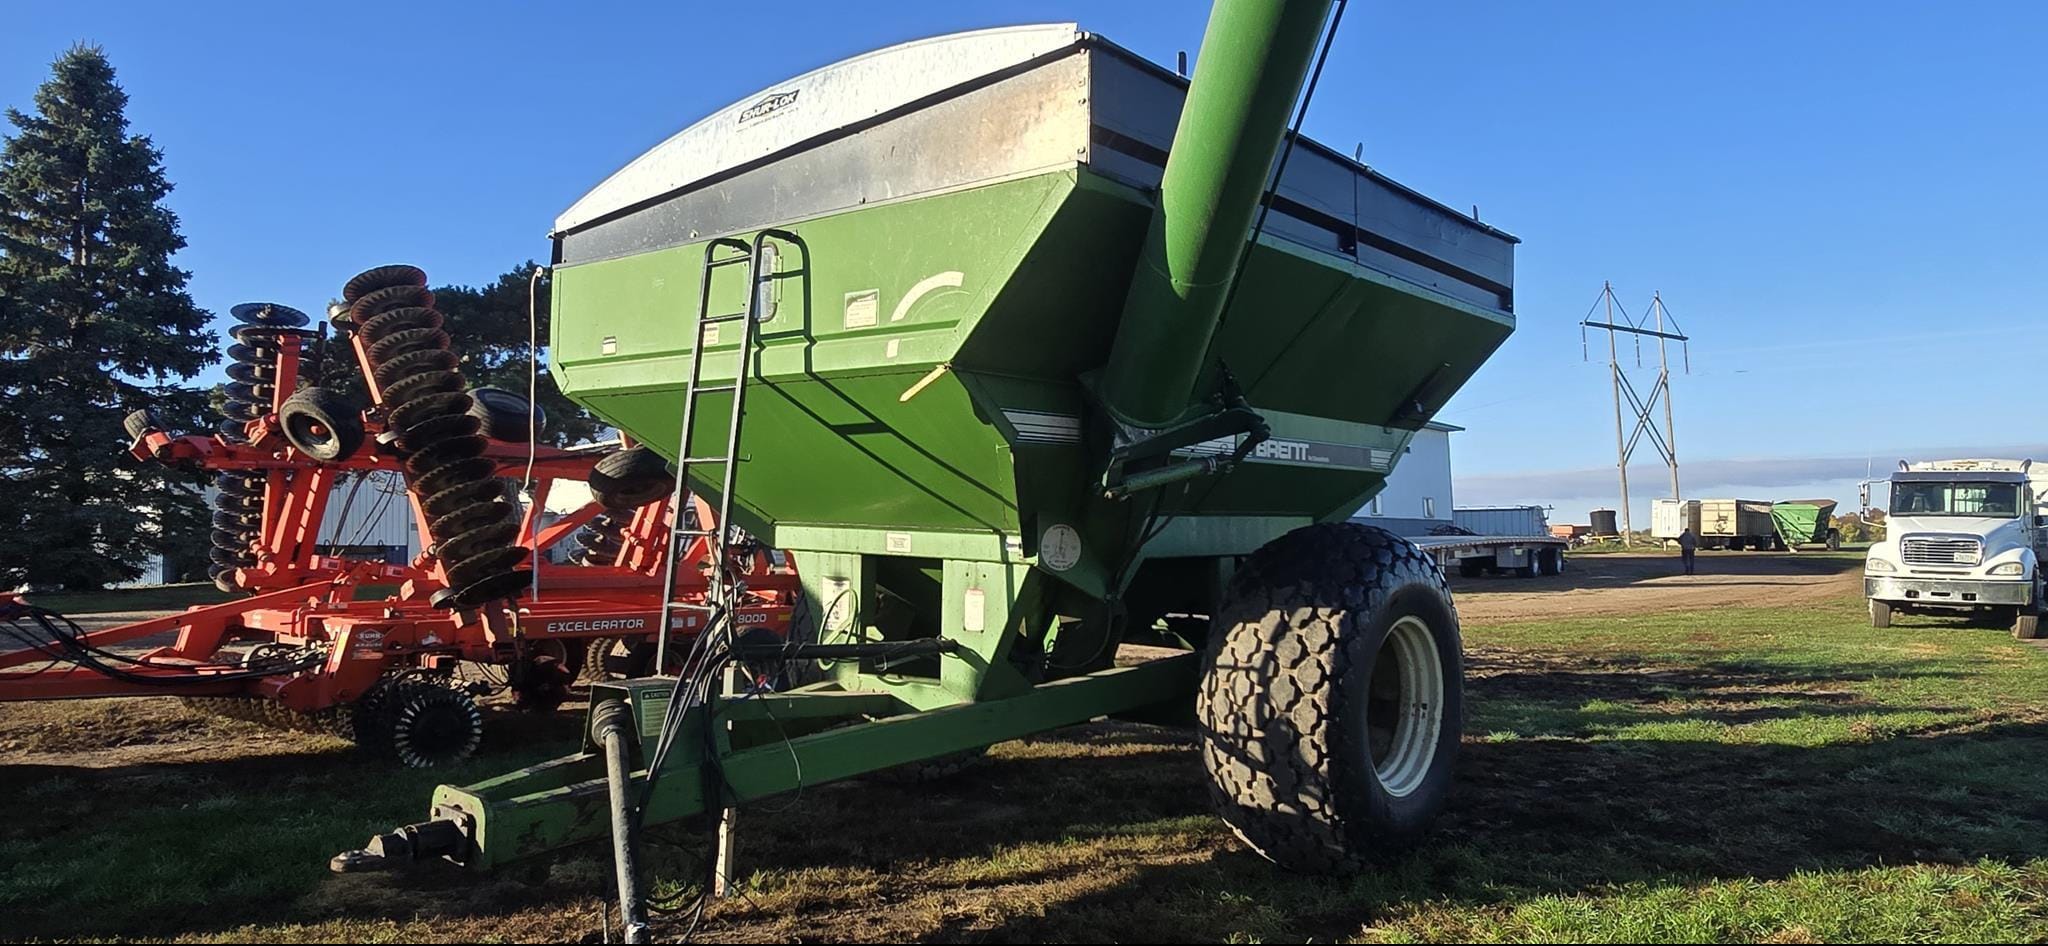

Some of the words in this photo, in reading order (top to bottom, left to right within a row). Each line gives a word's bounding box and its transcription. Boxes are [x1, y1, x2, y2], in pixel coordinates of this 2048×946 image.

[741, 93, 796, 120] SHUR-LOK
[1256, 439, 1310, 461] BRENT
[547, 619, 645, 633] EXCELERATOR
[737, 613, 767, 624] 8000
